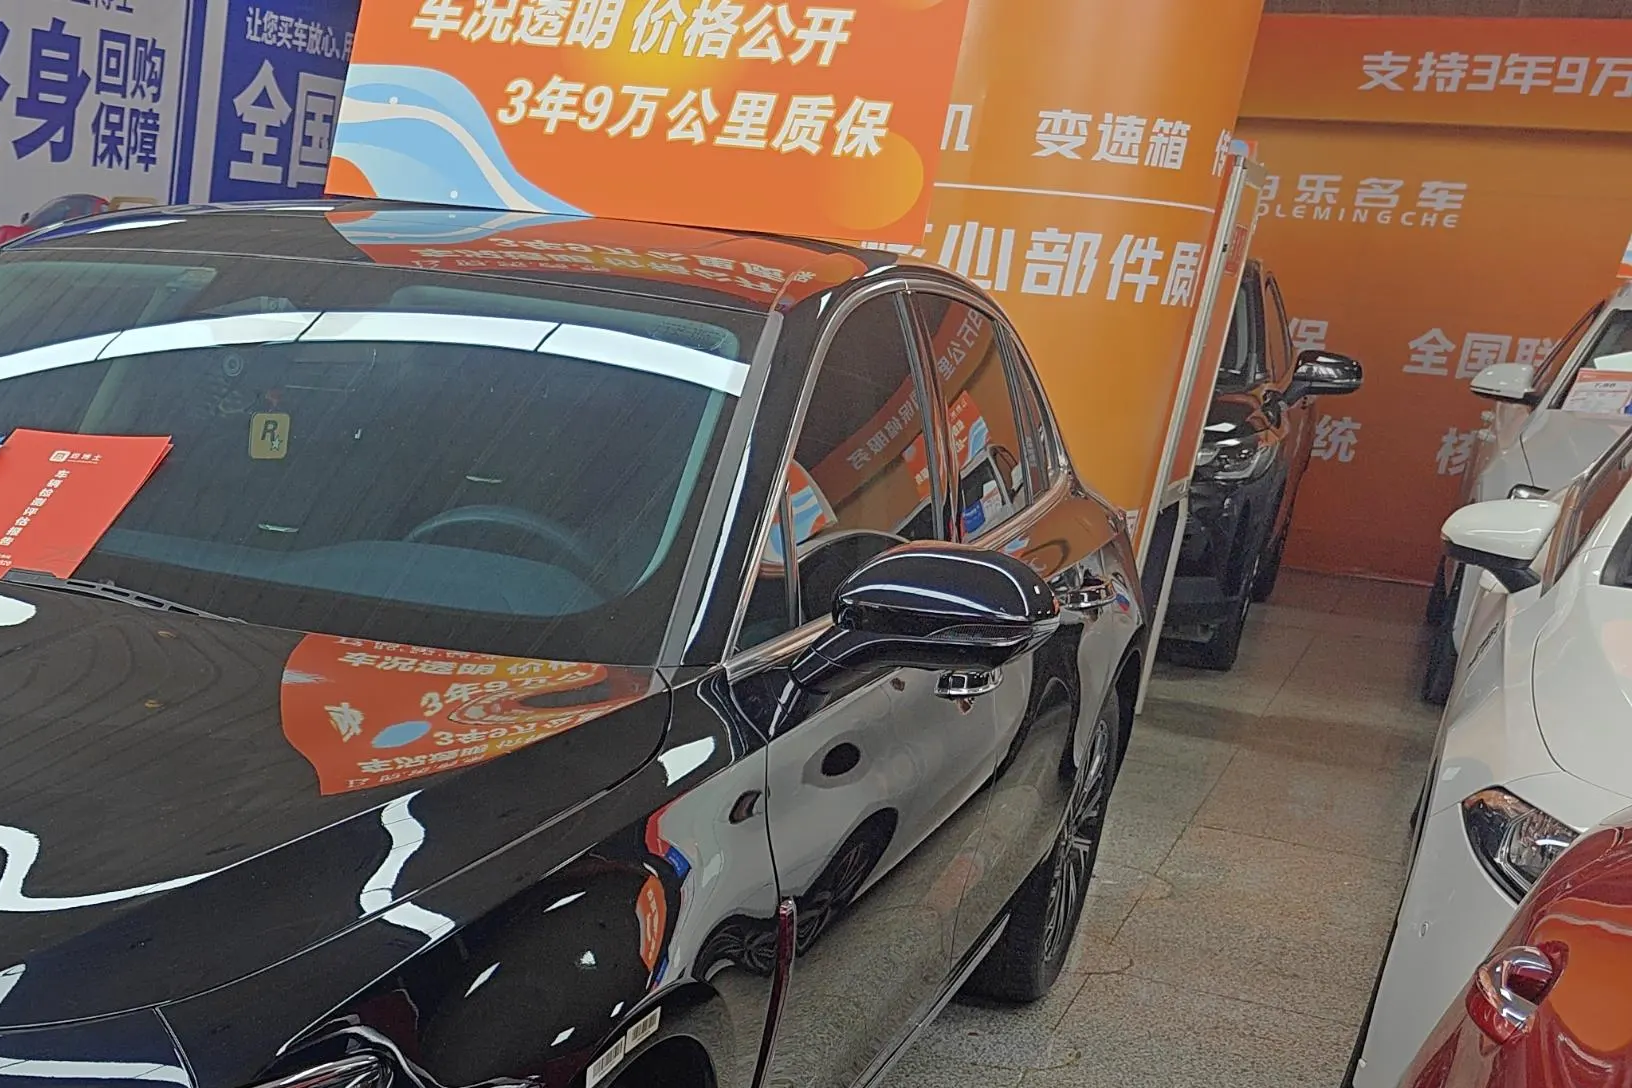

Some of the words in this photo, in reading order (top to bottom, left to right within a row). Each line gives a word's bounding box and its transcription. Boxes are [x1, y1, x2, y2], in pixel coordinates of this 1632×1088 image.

[96, 28, 166, 103] 回购
[412, 0, 621, 51] 车况透明
[629, 0, 857, 66] 价格公开
[1357, 51, 1632, 97] 支持3年9万
[91, 102, 161, 173] 保障
[496, 75, 894, 158] 3年9万公里质保
[1030, 108, 1191, 171] 变速箱
